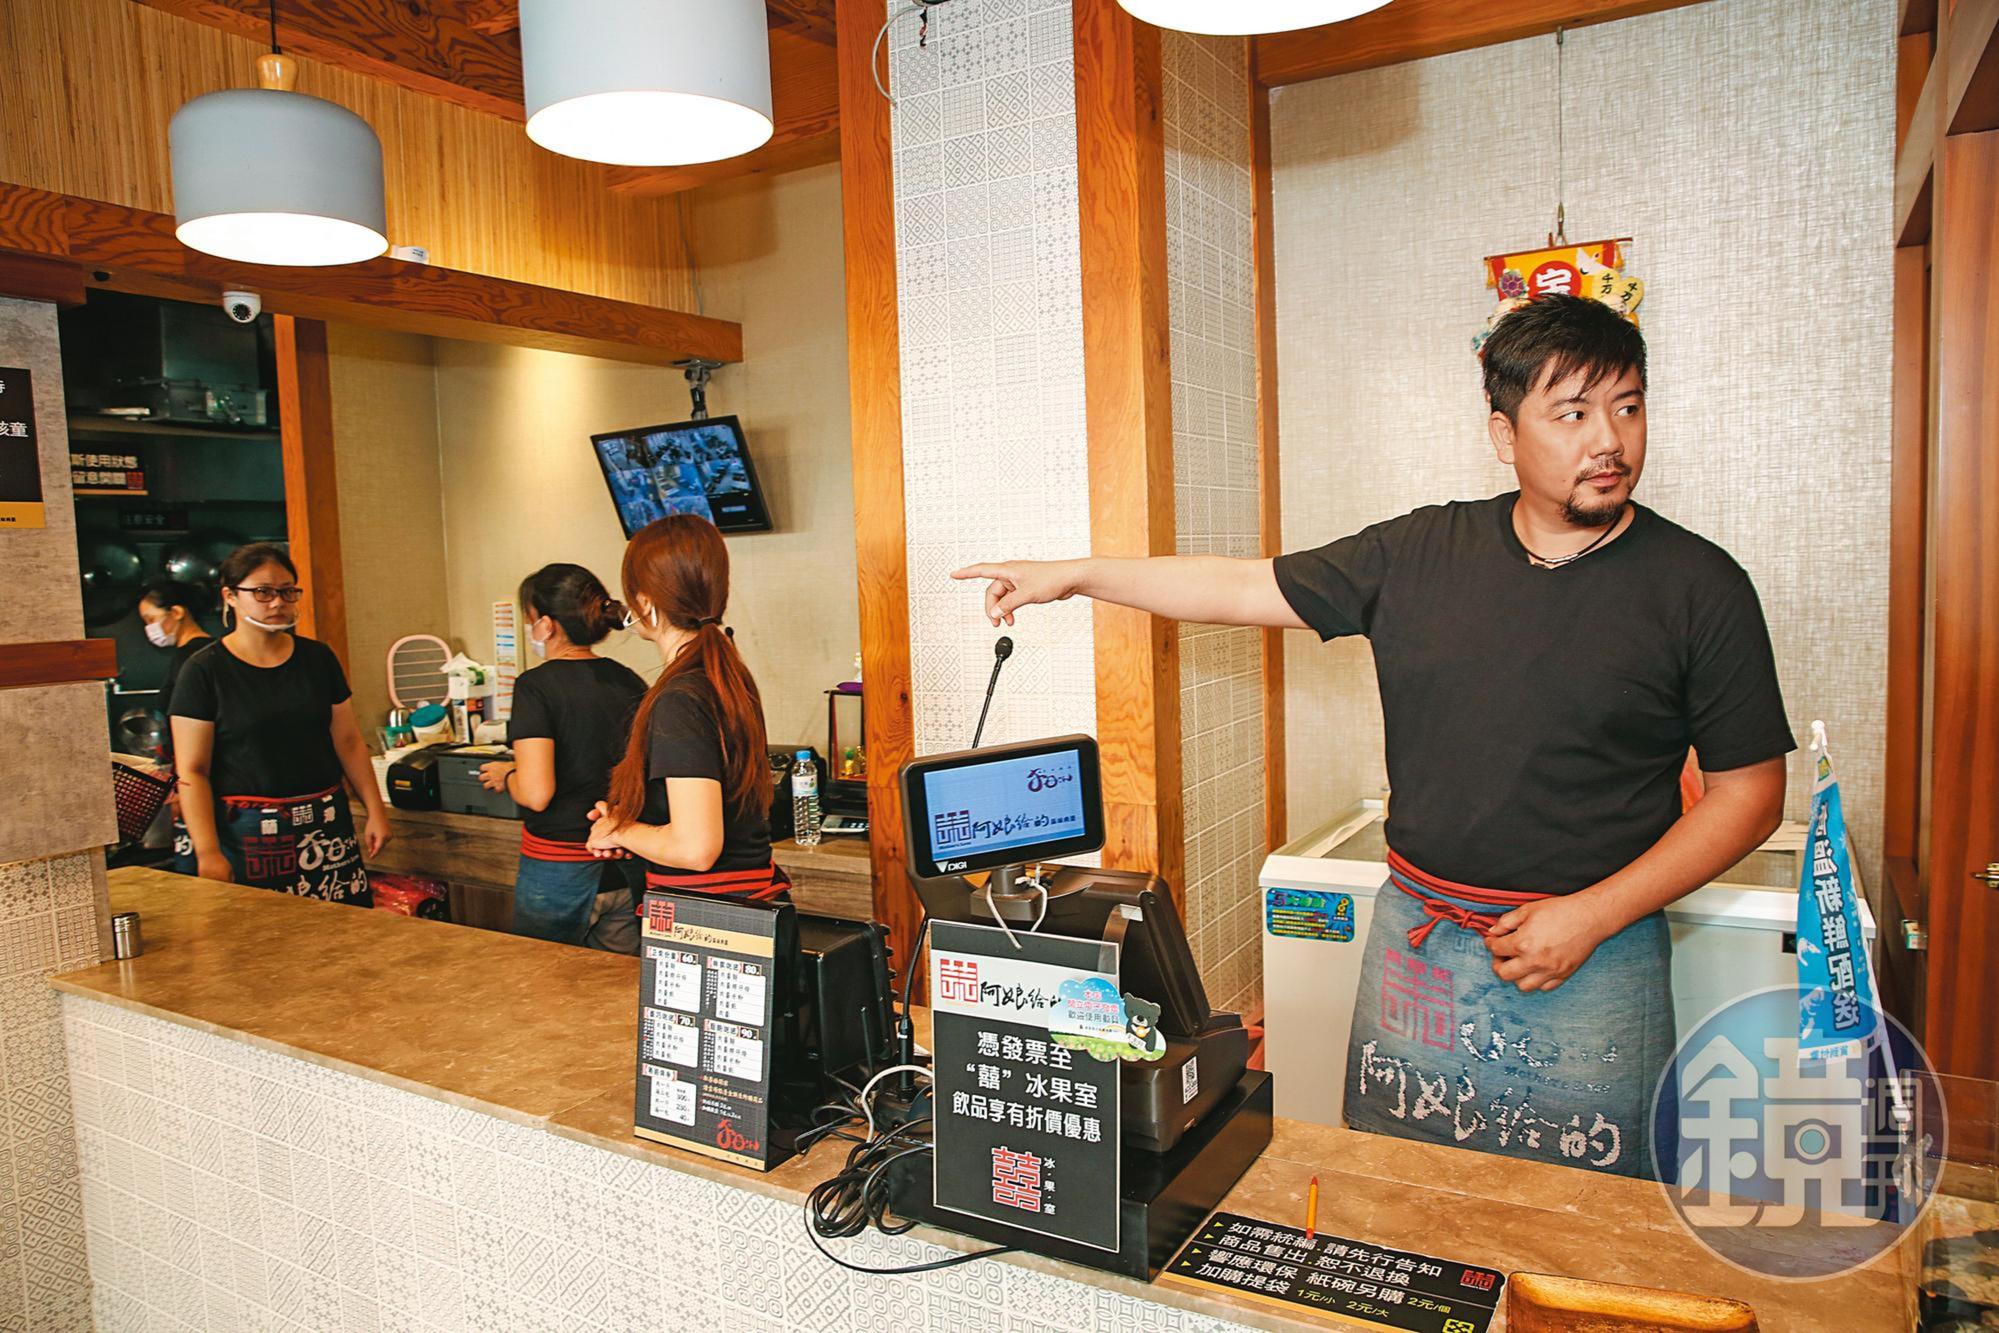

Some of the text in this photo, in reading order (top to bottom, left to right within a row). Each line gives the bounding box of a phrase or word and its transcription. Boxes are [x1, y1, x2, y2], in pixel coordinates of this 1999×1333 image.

[948, 861, 967, 871] DIGI
[977, 1030, 1073, 1071] 憑發票至
[1025, 1072, 1098, 1110] 冰果室
[952, 1091, 1102, 1143] 飲品享有折價優惠
[1196, 1263, 1291, 1295] 加購提袋
[1346, 1300, 1390, 1318] 2元/大
[1208, 1249, 1299, 1280] 響應環保
[1305, 1272, 1406, 1305] 紙碗另購
